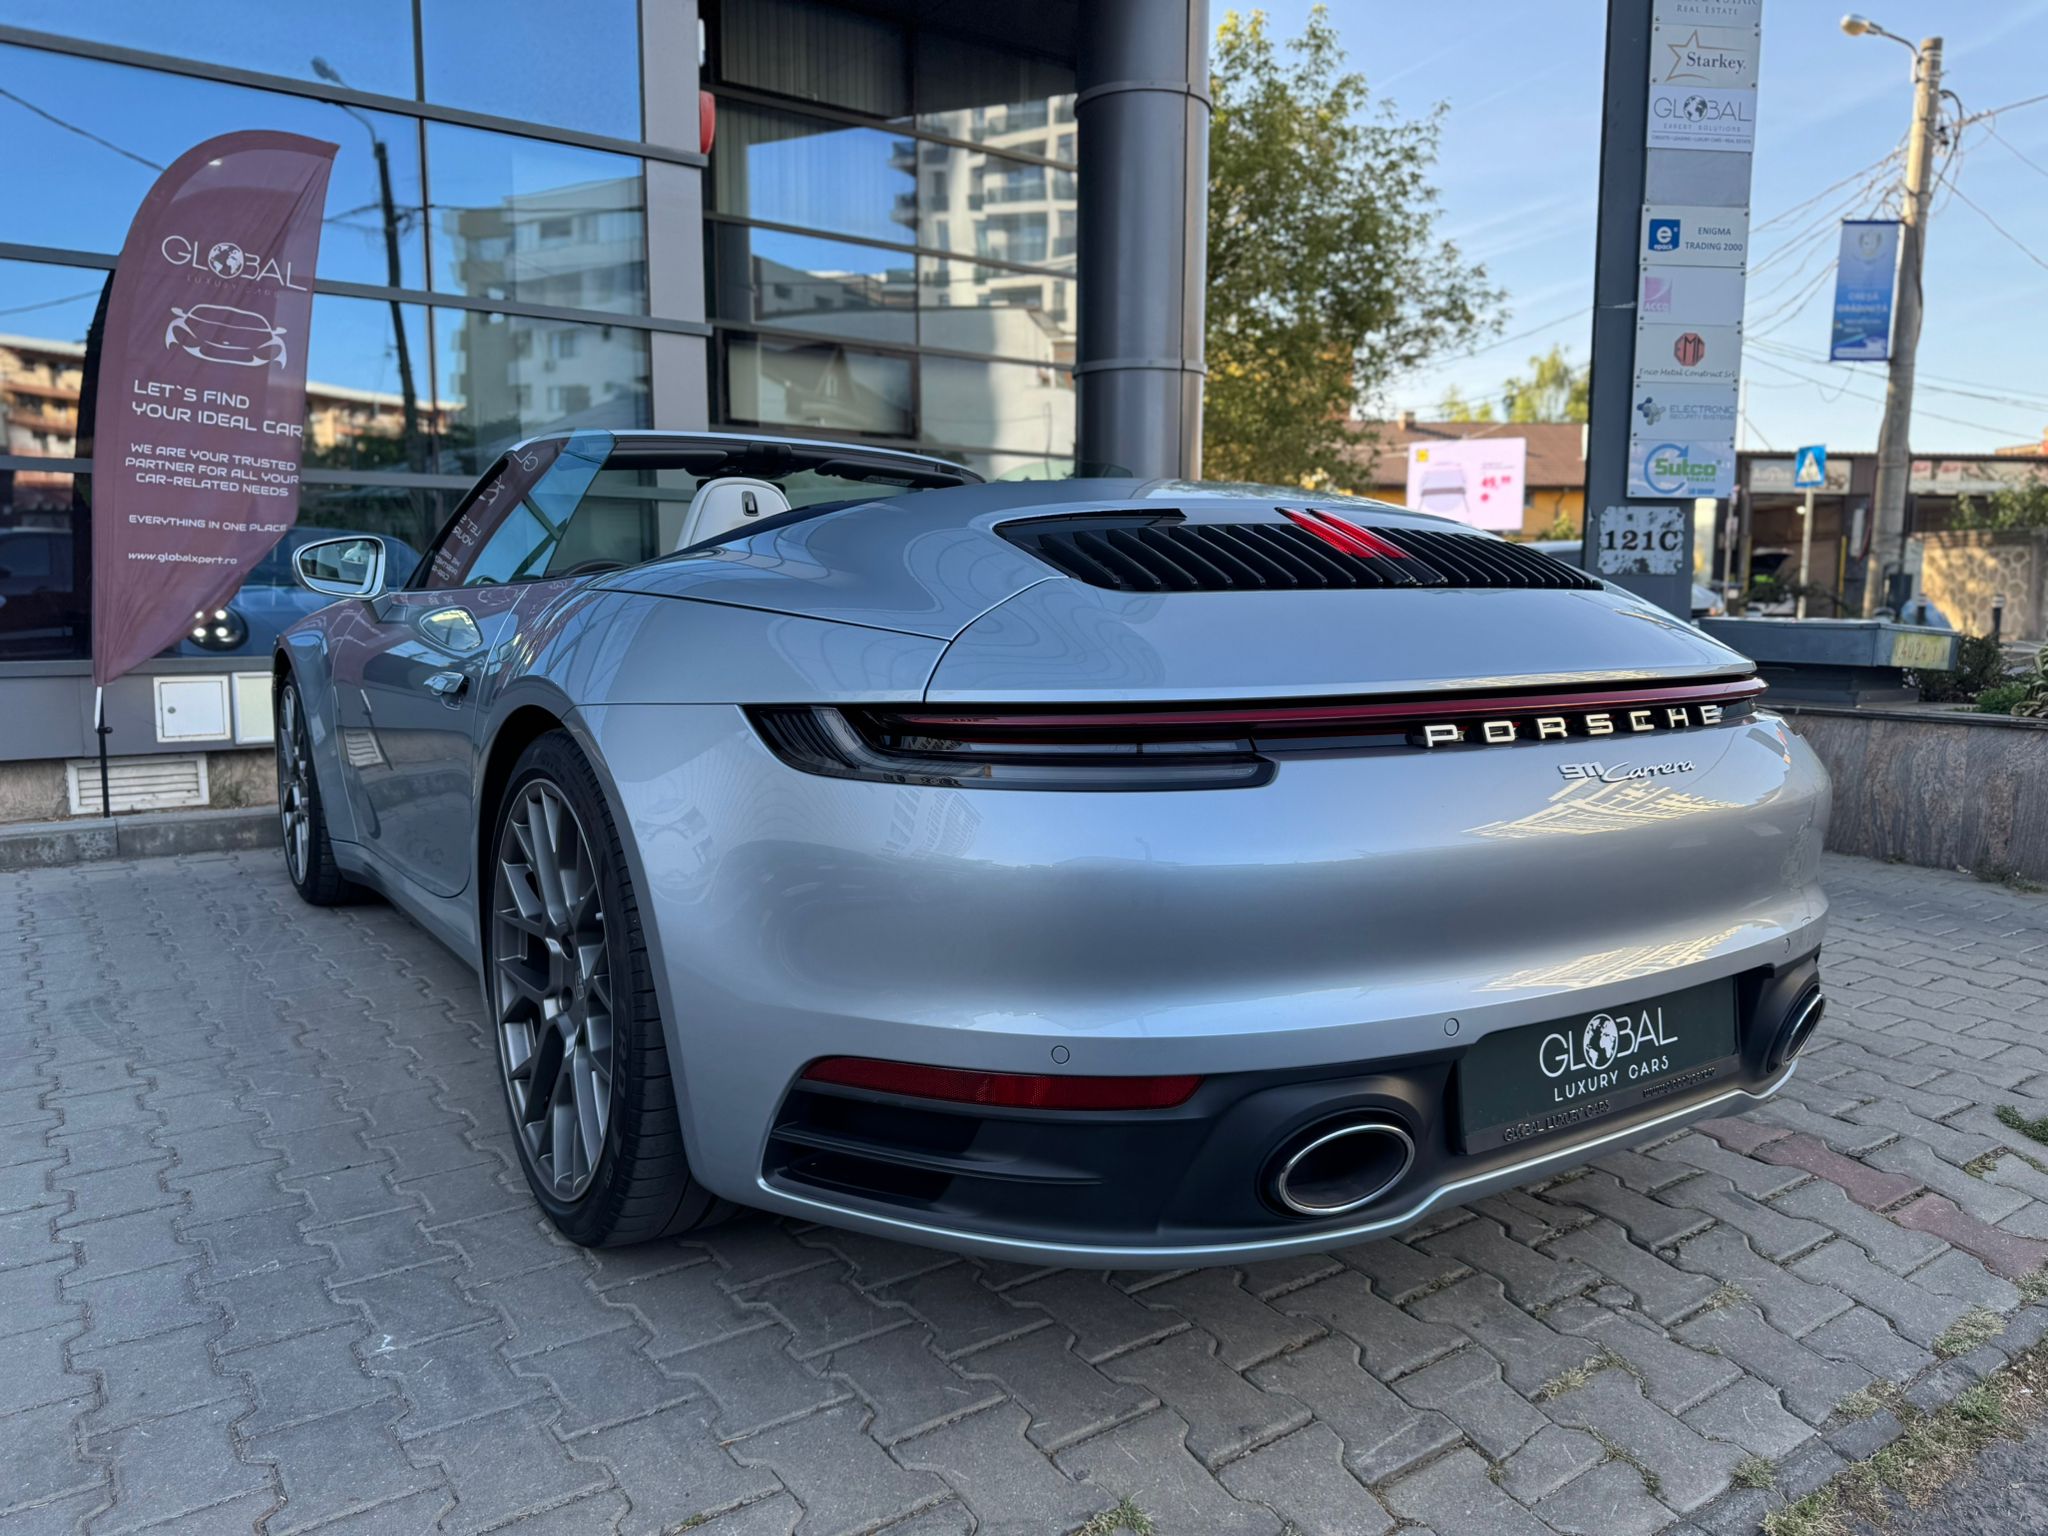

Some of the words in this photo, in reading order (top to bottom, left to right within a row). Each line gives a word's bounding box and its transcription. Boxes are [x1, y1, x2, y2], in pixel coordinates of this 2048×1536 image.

[1654, 94, 1752, 122] GLOBAL
[1698, 226, 1732, 236] ENIGMA
[1686, 242, 1722, 251] TRADING
[1724, 242, 1743, 252] 2000
[160, 234, 308, 292] GLOBAL
[204, 389, 250, 410] FIND
[132, 402, 192, 423] YOUR
[198, 410, 258, 432] IDEAL
[263, 420, 304, 438] CAR
[130, 443, 153, 456] WE
[156, 444, 186, 458] ARE
[190, 450, 228, 464] YOUR
[232, 454, 296, 471] TRUSTED
[1655, 458, 1716, 476] Sutco
[125, 456, 194, 474] PARTNER
[198, 465, 227, 478] FOR
[231, 467, 258, 480] ALL
[261, 470, 299, 484] YOUR
[136, 472, 239, 493] CAR-RELATED
[242, 484, 288, 497] NEEDS
[129, 514, 205, 528] EVERYTHING
[208, 520, 220, 529] IN
[222, 522, 246, 532] ONE
[249, 522, 288, 533] PLACE
[1604, 530, 1680, 552] 121C
[128, 551, 238, 566] www.globalxpert.ro
[1424, 704, 1722, 748] PORSCHE
[1558, 760, 1604, 780] 911
[1602, 760, 1696, 782] Carrera
[1539, 1006, 1678, 1078] GLOBAL
[1554, 1070, 1619, 1102] LUXURY
[1628, 1054, 1670, 1080] CARS
